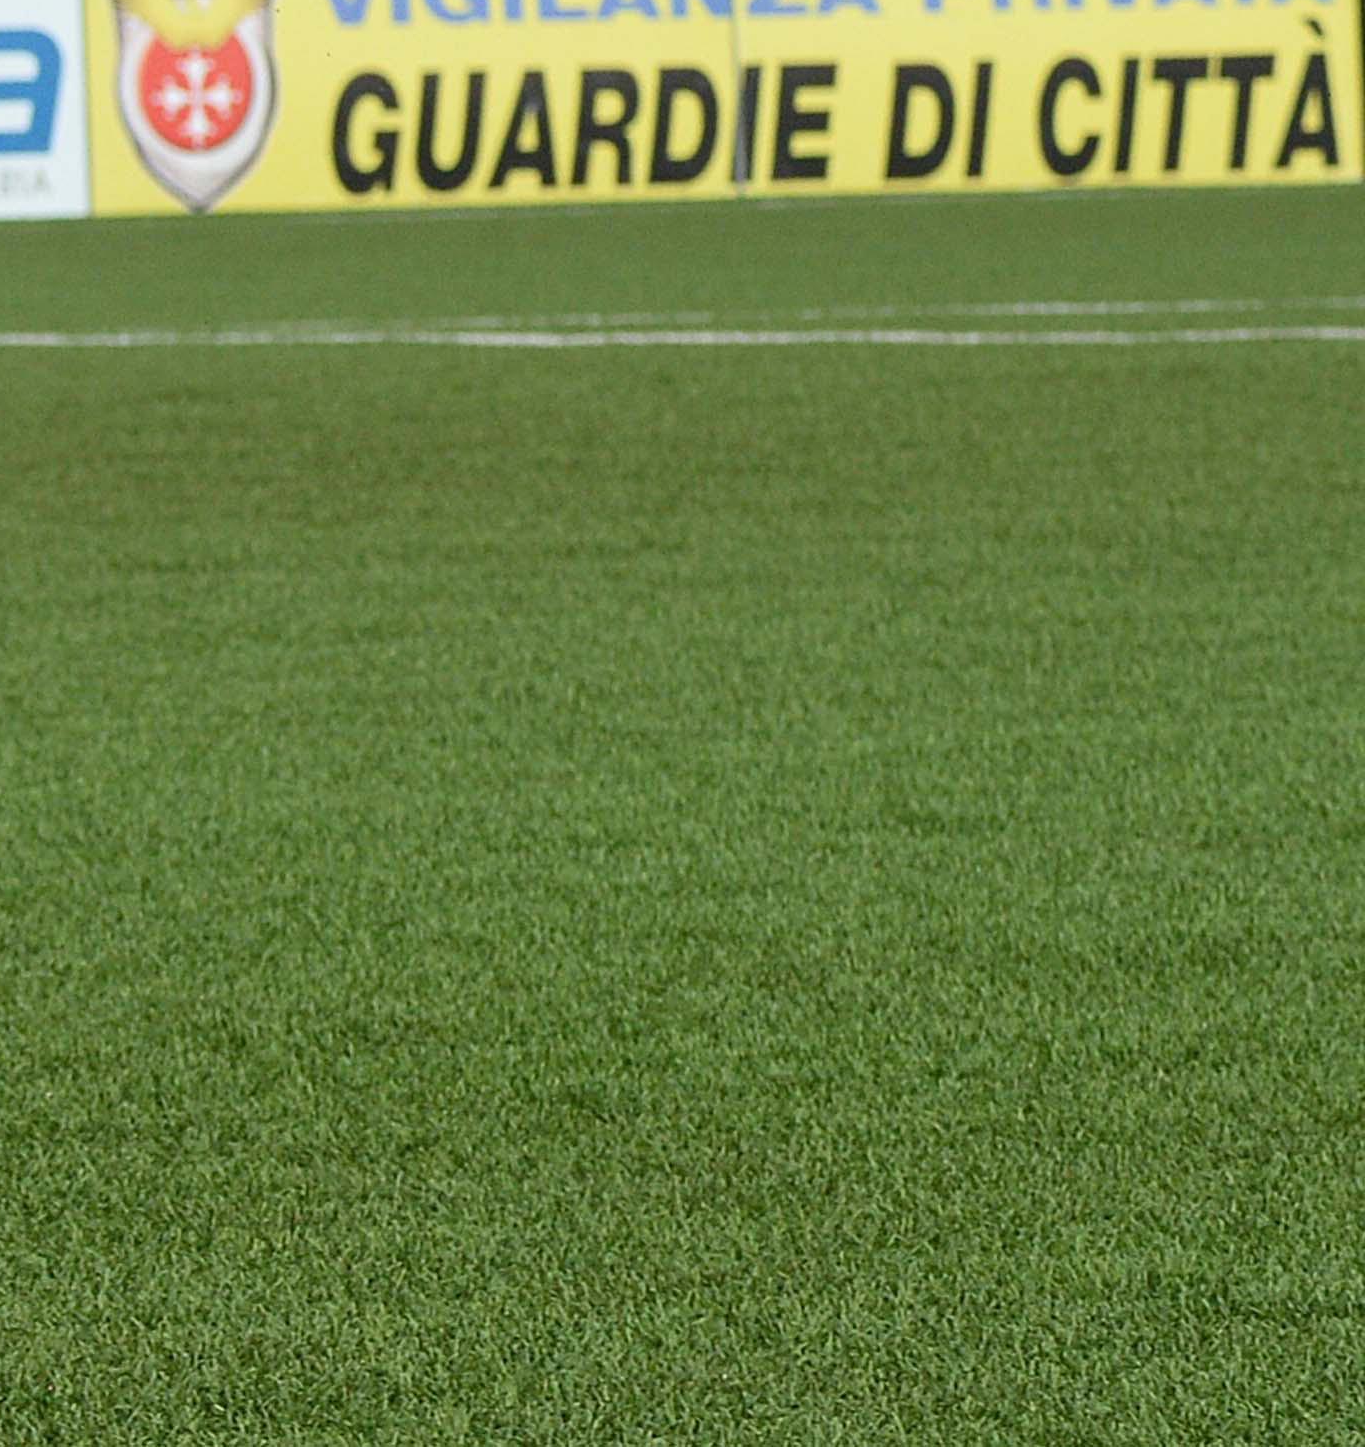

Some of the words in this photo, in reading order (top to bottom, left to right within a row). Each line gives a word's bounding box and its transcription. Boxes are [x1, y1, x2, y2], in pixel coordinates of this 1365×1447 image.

[332, 60, 837, 195] GUARDIE
[884, 58, 993, 180] DI
[1037, 17, 1339, 177] CITTÀ
